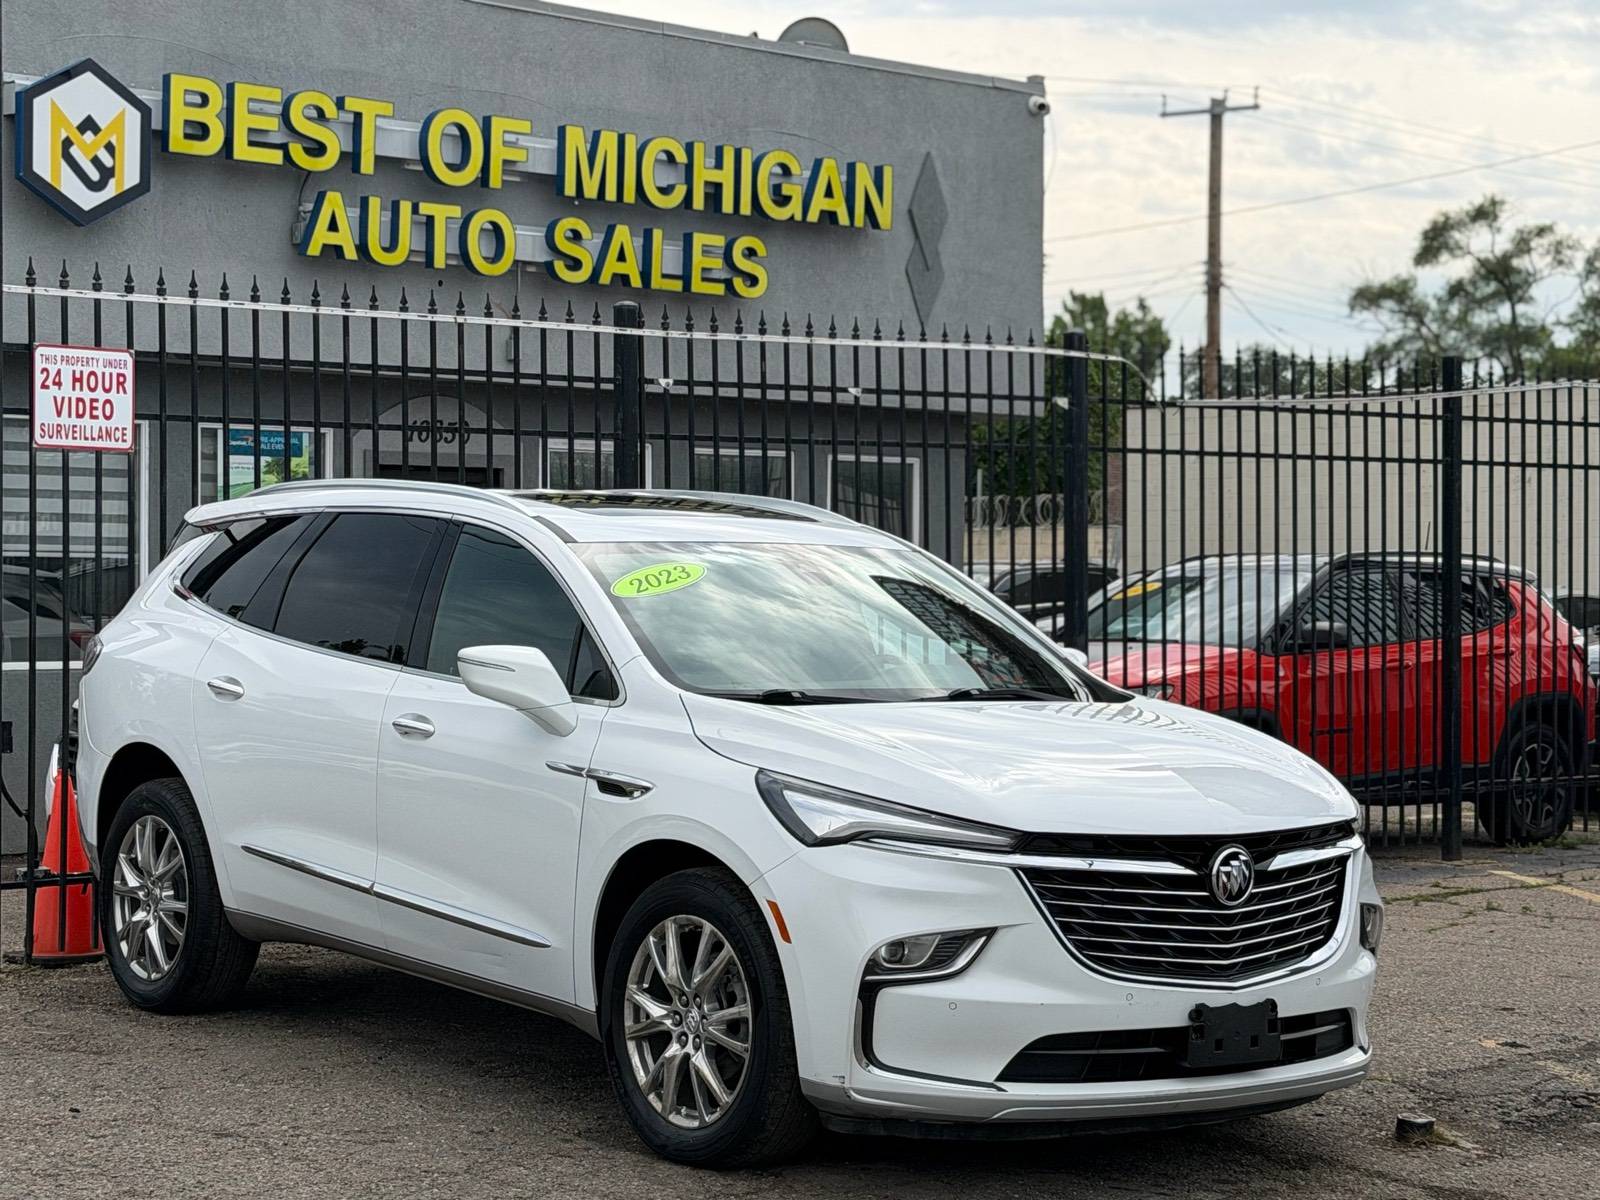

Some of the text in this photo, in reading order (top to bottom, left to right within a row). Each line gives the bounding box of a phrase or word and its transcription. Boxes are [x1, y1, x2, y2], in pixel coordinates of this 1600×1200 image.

[165, 72, 894, 231] BEST OF MICHIGAN
[303, 190, 769, 299] AUTO SALES
[40, 353, 128, 370] THIS PROPERTY UNDER
[40, 367, 128, 395] 24 HOUR
[53, 395, 115, 421] VIDEO
[39, 422, 128, 443] SURVEILLANCE
[628, 565, 692, 594] 2023
